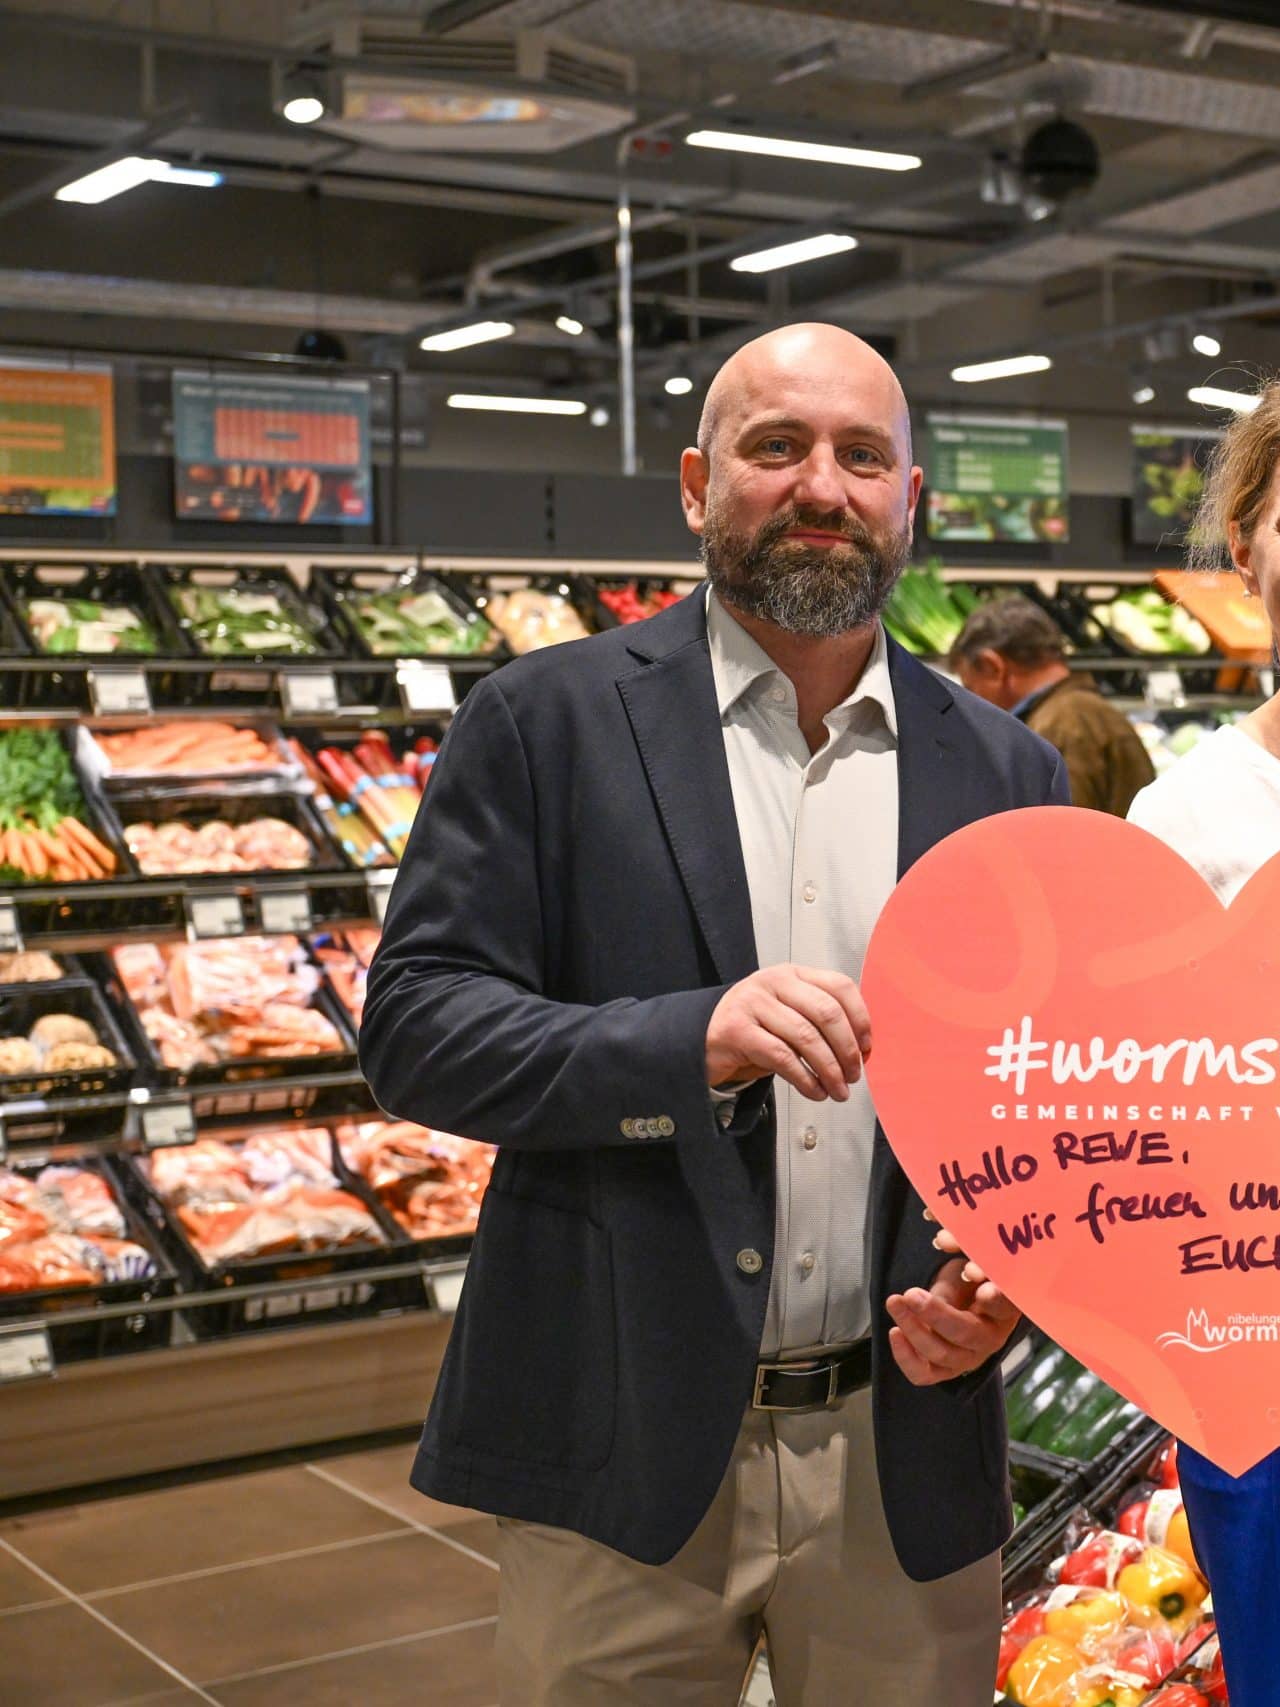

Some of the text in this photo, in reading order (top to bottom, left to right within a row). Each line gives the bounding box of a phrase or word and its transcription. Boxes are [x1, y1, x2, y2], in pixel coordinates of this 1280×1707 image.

[991, 1104, 1254, 1121] GEMEINSCHAFT
[937, 1145, 1038, 1210] Hallo
[1075, 1182, 1207, 1244] freuen
